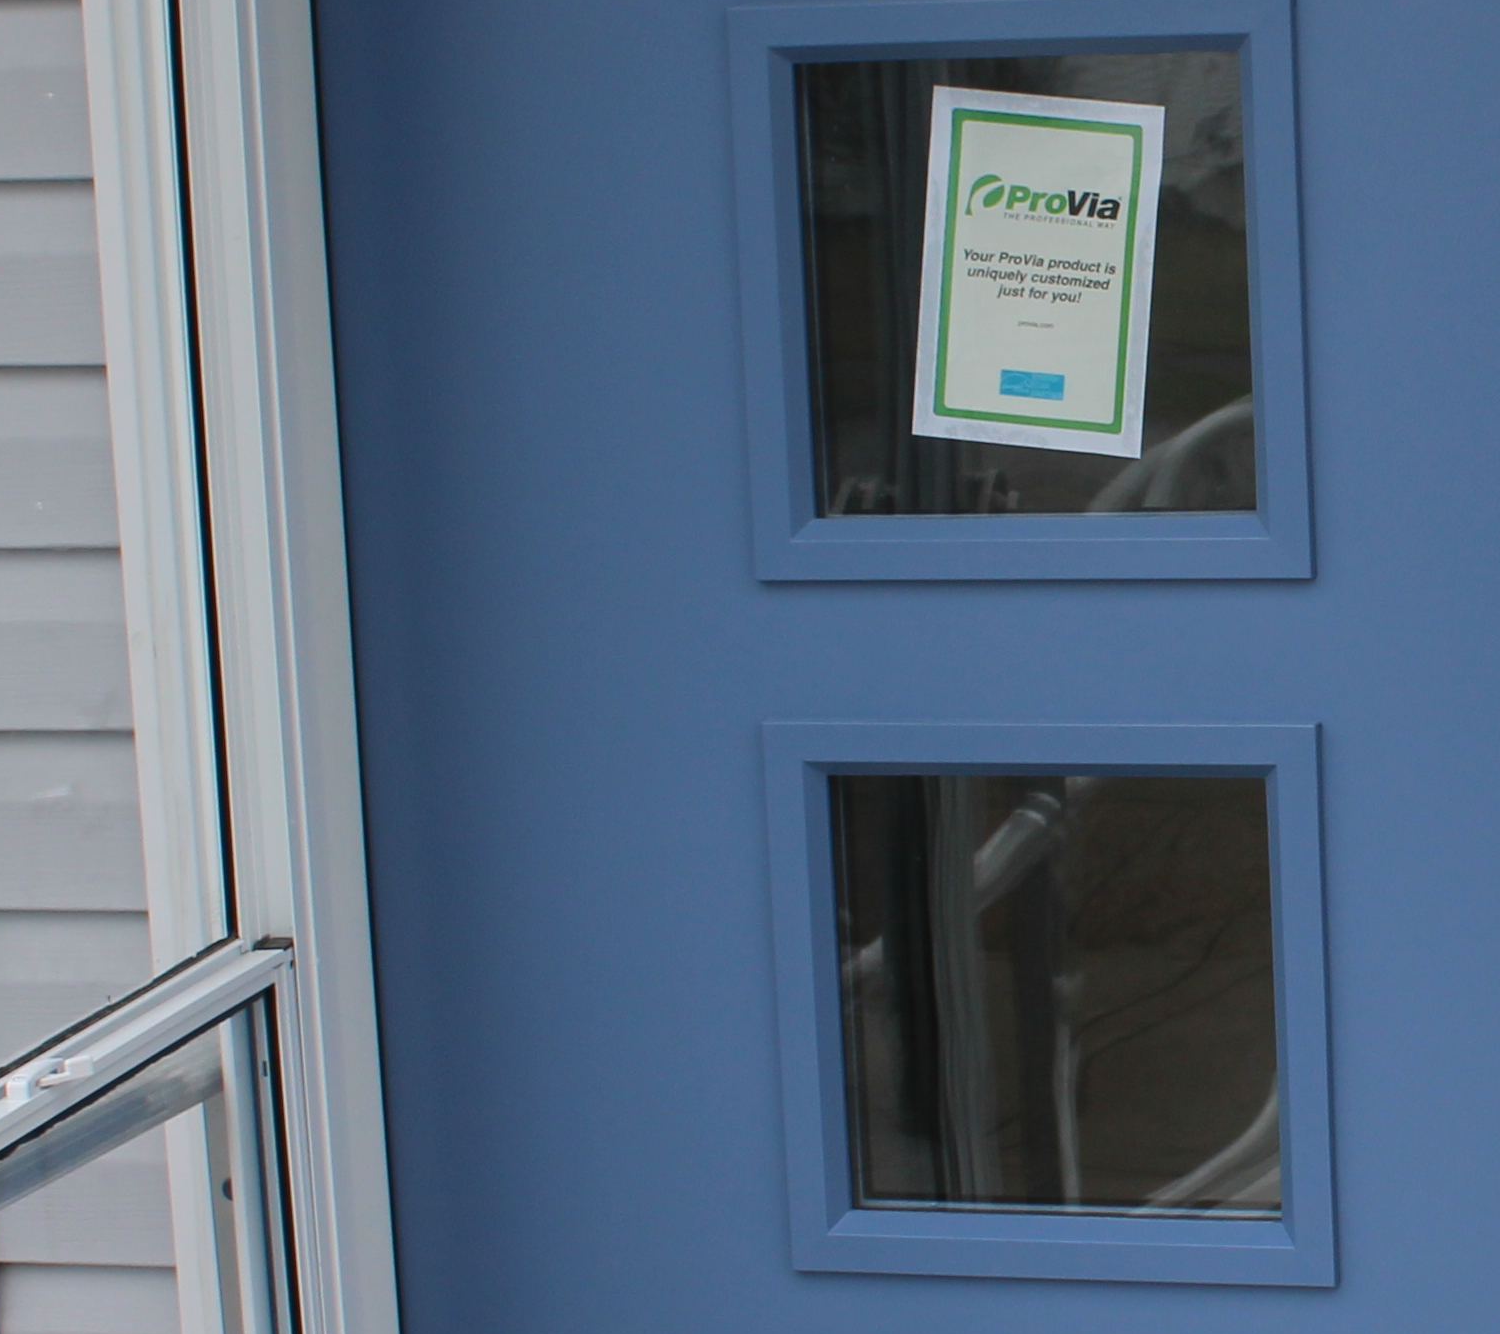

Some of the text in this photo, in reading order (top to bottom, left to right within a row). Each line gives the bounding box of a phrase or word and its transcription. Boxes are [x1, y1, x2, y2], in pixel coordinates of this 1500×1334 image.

[1005, 184, 1121, 221] ProVia
[1003, 212, 1116, 230] THE PROFESSIONAL WAY
[963, 248, 1117, 275] Your ProVia product is
[967, 266, 1111, 290] uniquely customized
[996, 284, 1083, 304] just for you!
